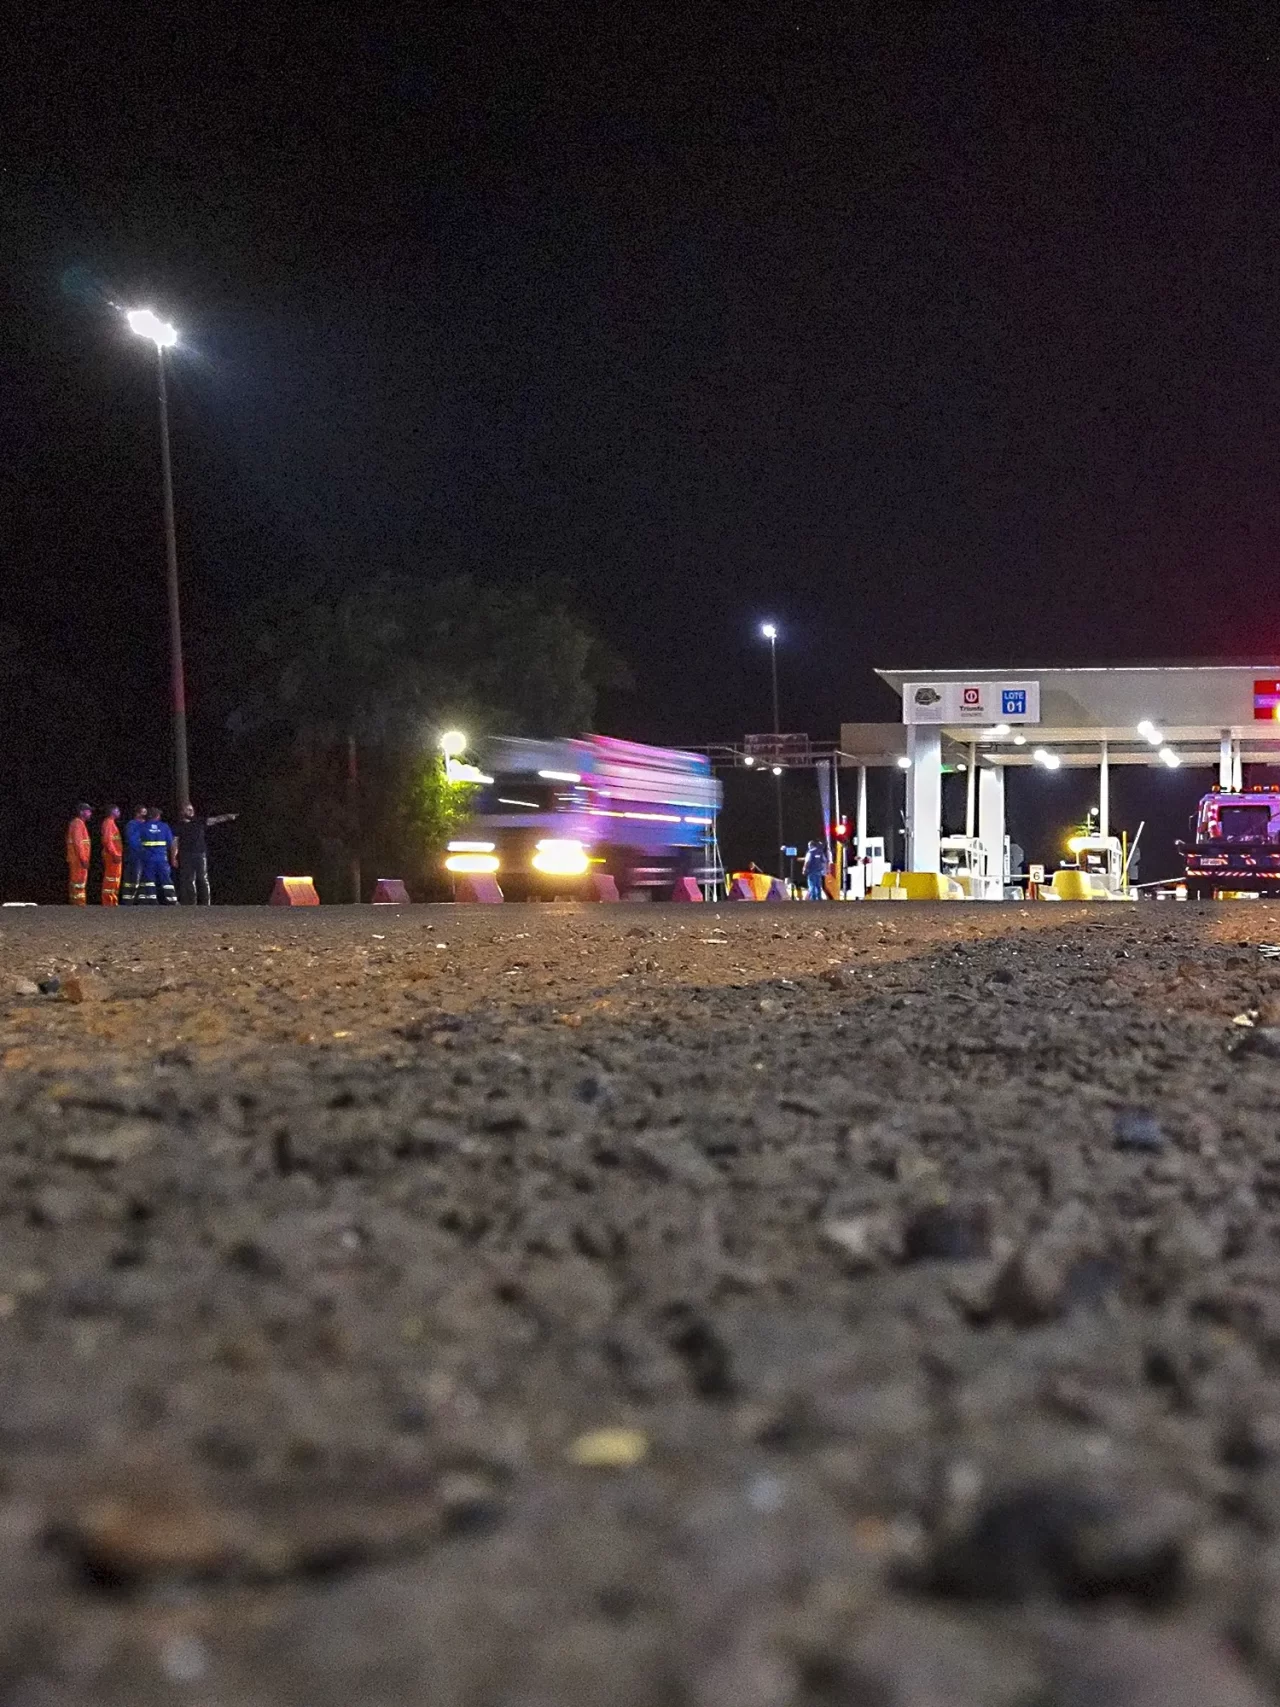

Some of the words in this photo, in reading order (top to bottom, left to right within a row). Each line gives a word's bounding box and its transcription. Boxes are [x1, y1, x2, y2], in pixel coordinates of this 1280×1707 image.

[1003, 692, 1024, 700] LOTE
[1006, 701, 1023, 712] 01
[1033, 871, 1041, 881] 6
